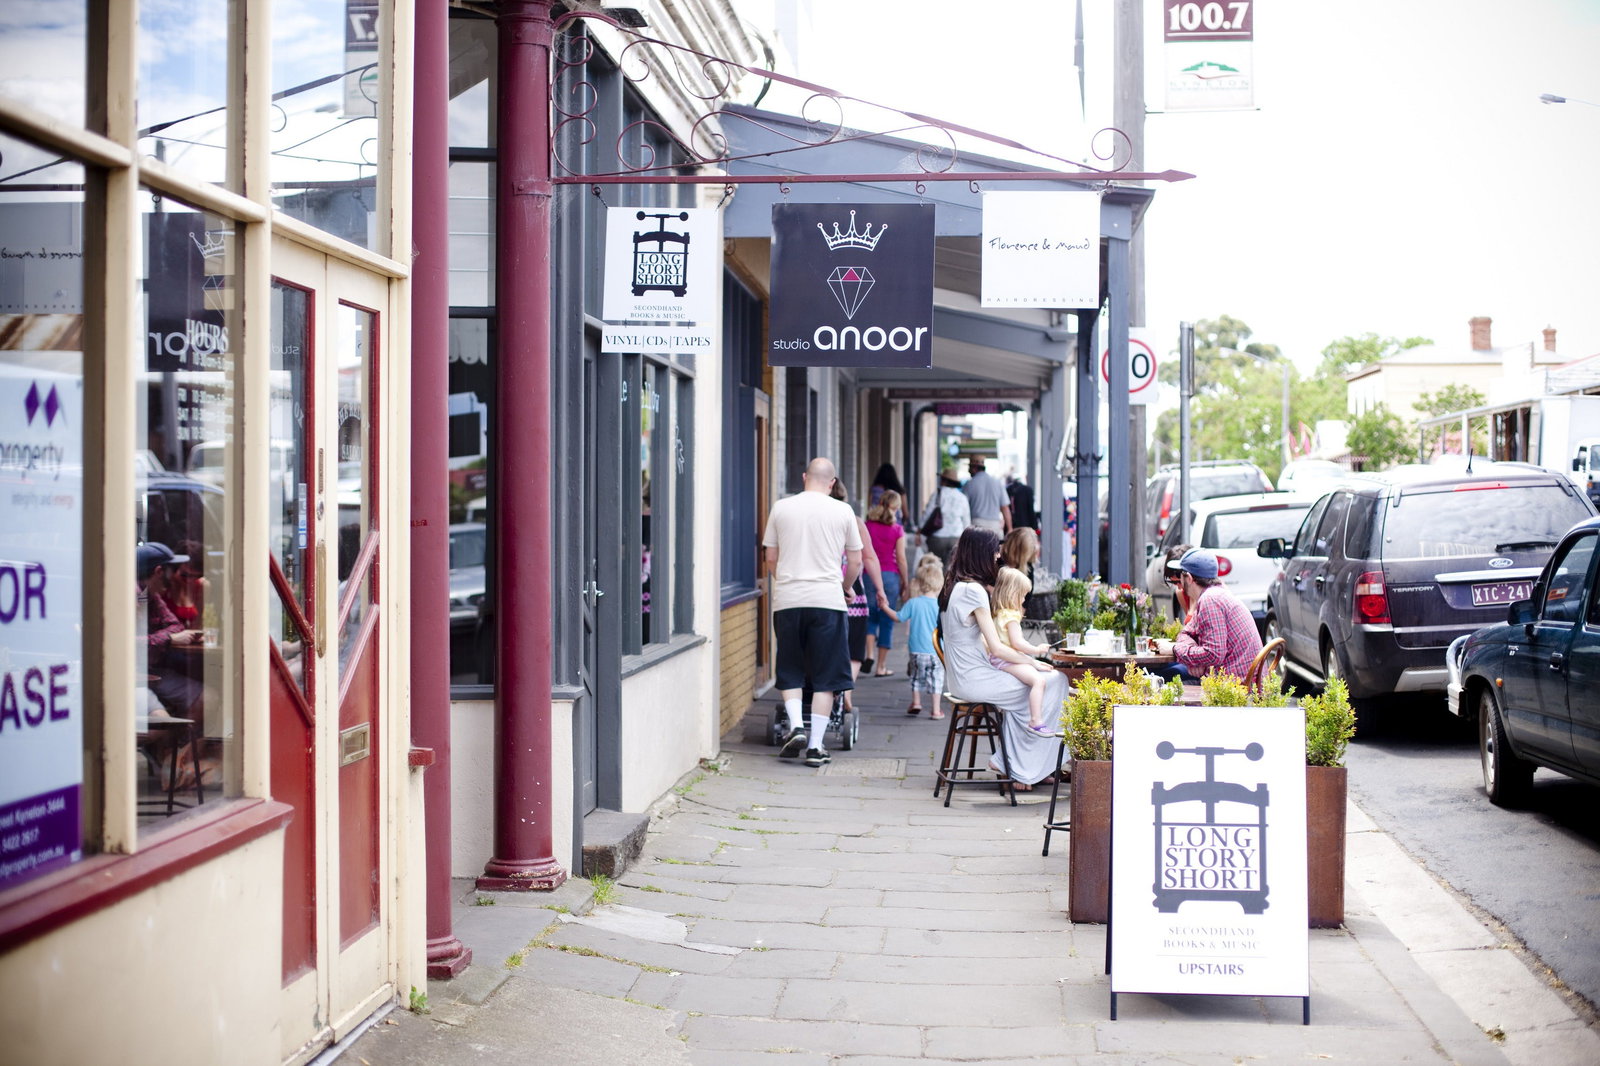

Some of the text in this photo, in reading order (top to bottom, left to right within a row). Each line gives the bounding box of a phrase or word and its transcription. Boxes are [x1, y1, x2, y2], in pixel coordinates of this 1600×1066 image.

[1168, 2, 1250, 31] 100.7
[988, 237, 1039, 251] Florence
[640, 253, 681, 264] LONG
[638, 264, 682, 275] STORY
[637, 274, 682, 285] SHORT
[633, 304, 683, 312] SECONDHAND
[186, 319, 229, 352] HOURS
[605, 335, 642, 346] VINYL
[673, 336, 711, 347] TAPES
[773, 325, 928, 351] studio anoor
[1131, 353, 1150, 379] 0
[0, 561, 47, 624] OR
[1392, 585, 1435, 593] TERRITORY
[0, 664, 70, 734] ASE
[1168, 826, 1253, 847] LONG
[1165, 847, 1256, 869] STORY
[1164, 868, 1258, 889] SHORT
[1168, 926, 1255, 936] SECONDHAND
[1163, 939, 1206, 949] BOOKS
[1221, 940, 1261, 950] MUSIC
[1178, 963, 1245, 976] UPSTAIRS
